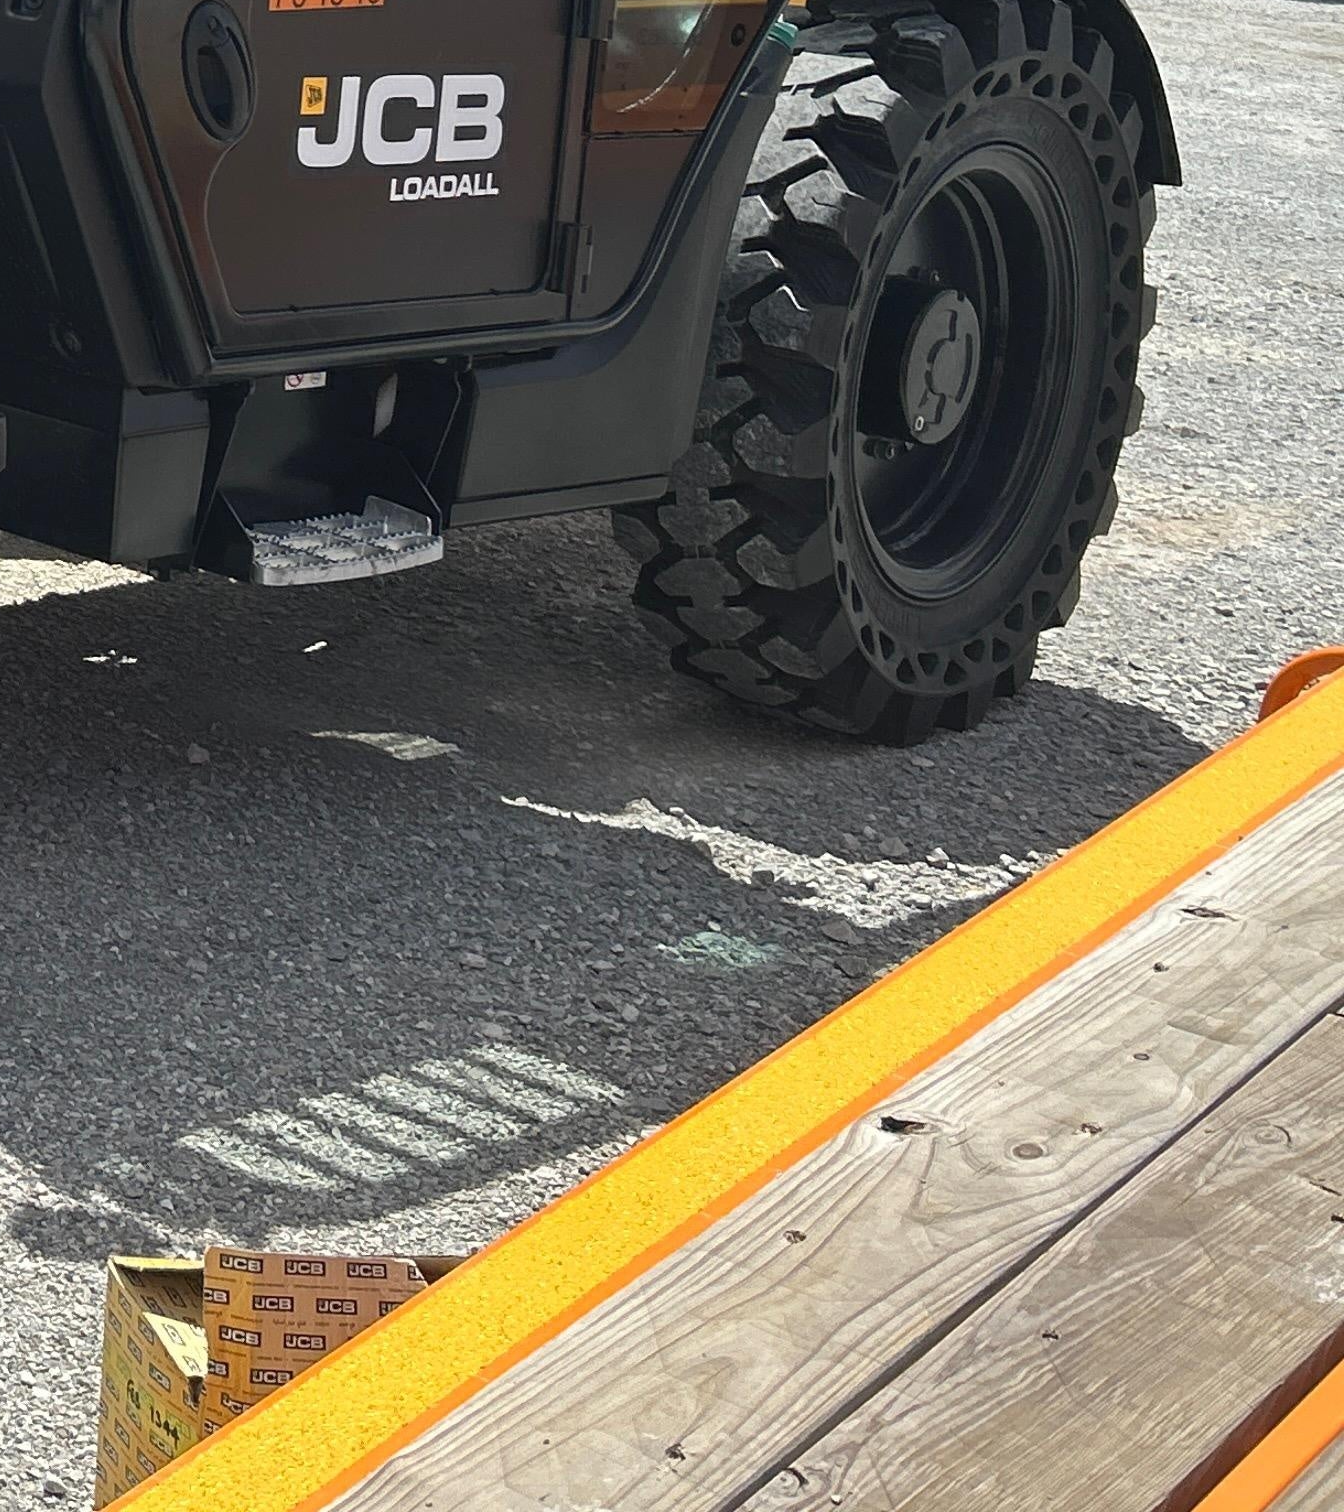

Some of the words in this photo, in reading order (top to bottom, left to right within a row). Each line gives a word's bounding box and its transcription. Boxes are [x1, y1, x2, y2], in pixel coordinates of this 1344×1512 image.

[297, 73, 506, 168] JCB
[389, 172, 500, 202] LOADALL
[221, 1256, 262, 1273] JCB
[286, 1261, 324, 1276] JCB
[348, 1264, 386, 1278] JCB
[204, 1289, 229, 1304] CB
[254, 1296, 292, 1311] JCB
[318, 1300, 356, 1314] JCB
[221, 1327, 260, 1345] JCB
[285, 1334, 325, 1350] JCB
[207, 1360, 228, 1376] CB
